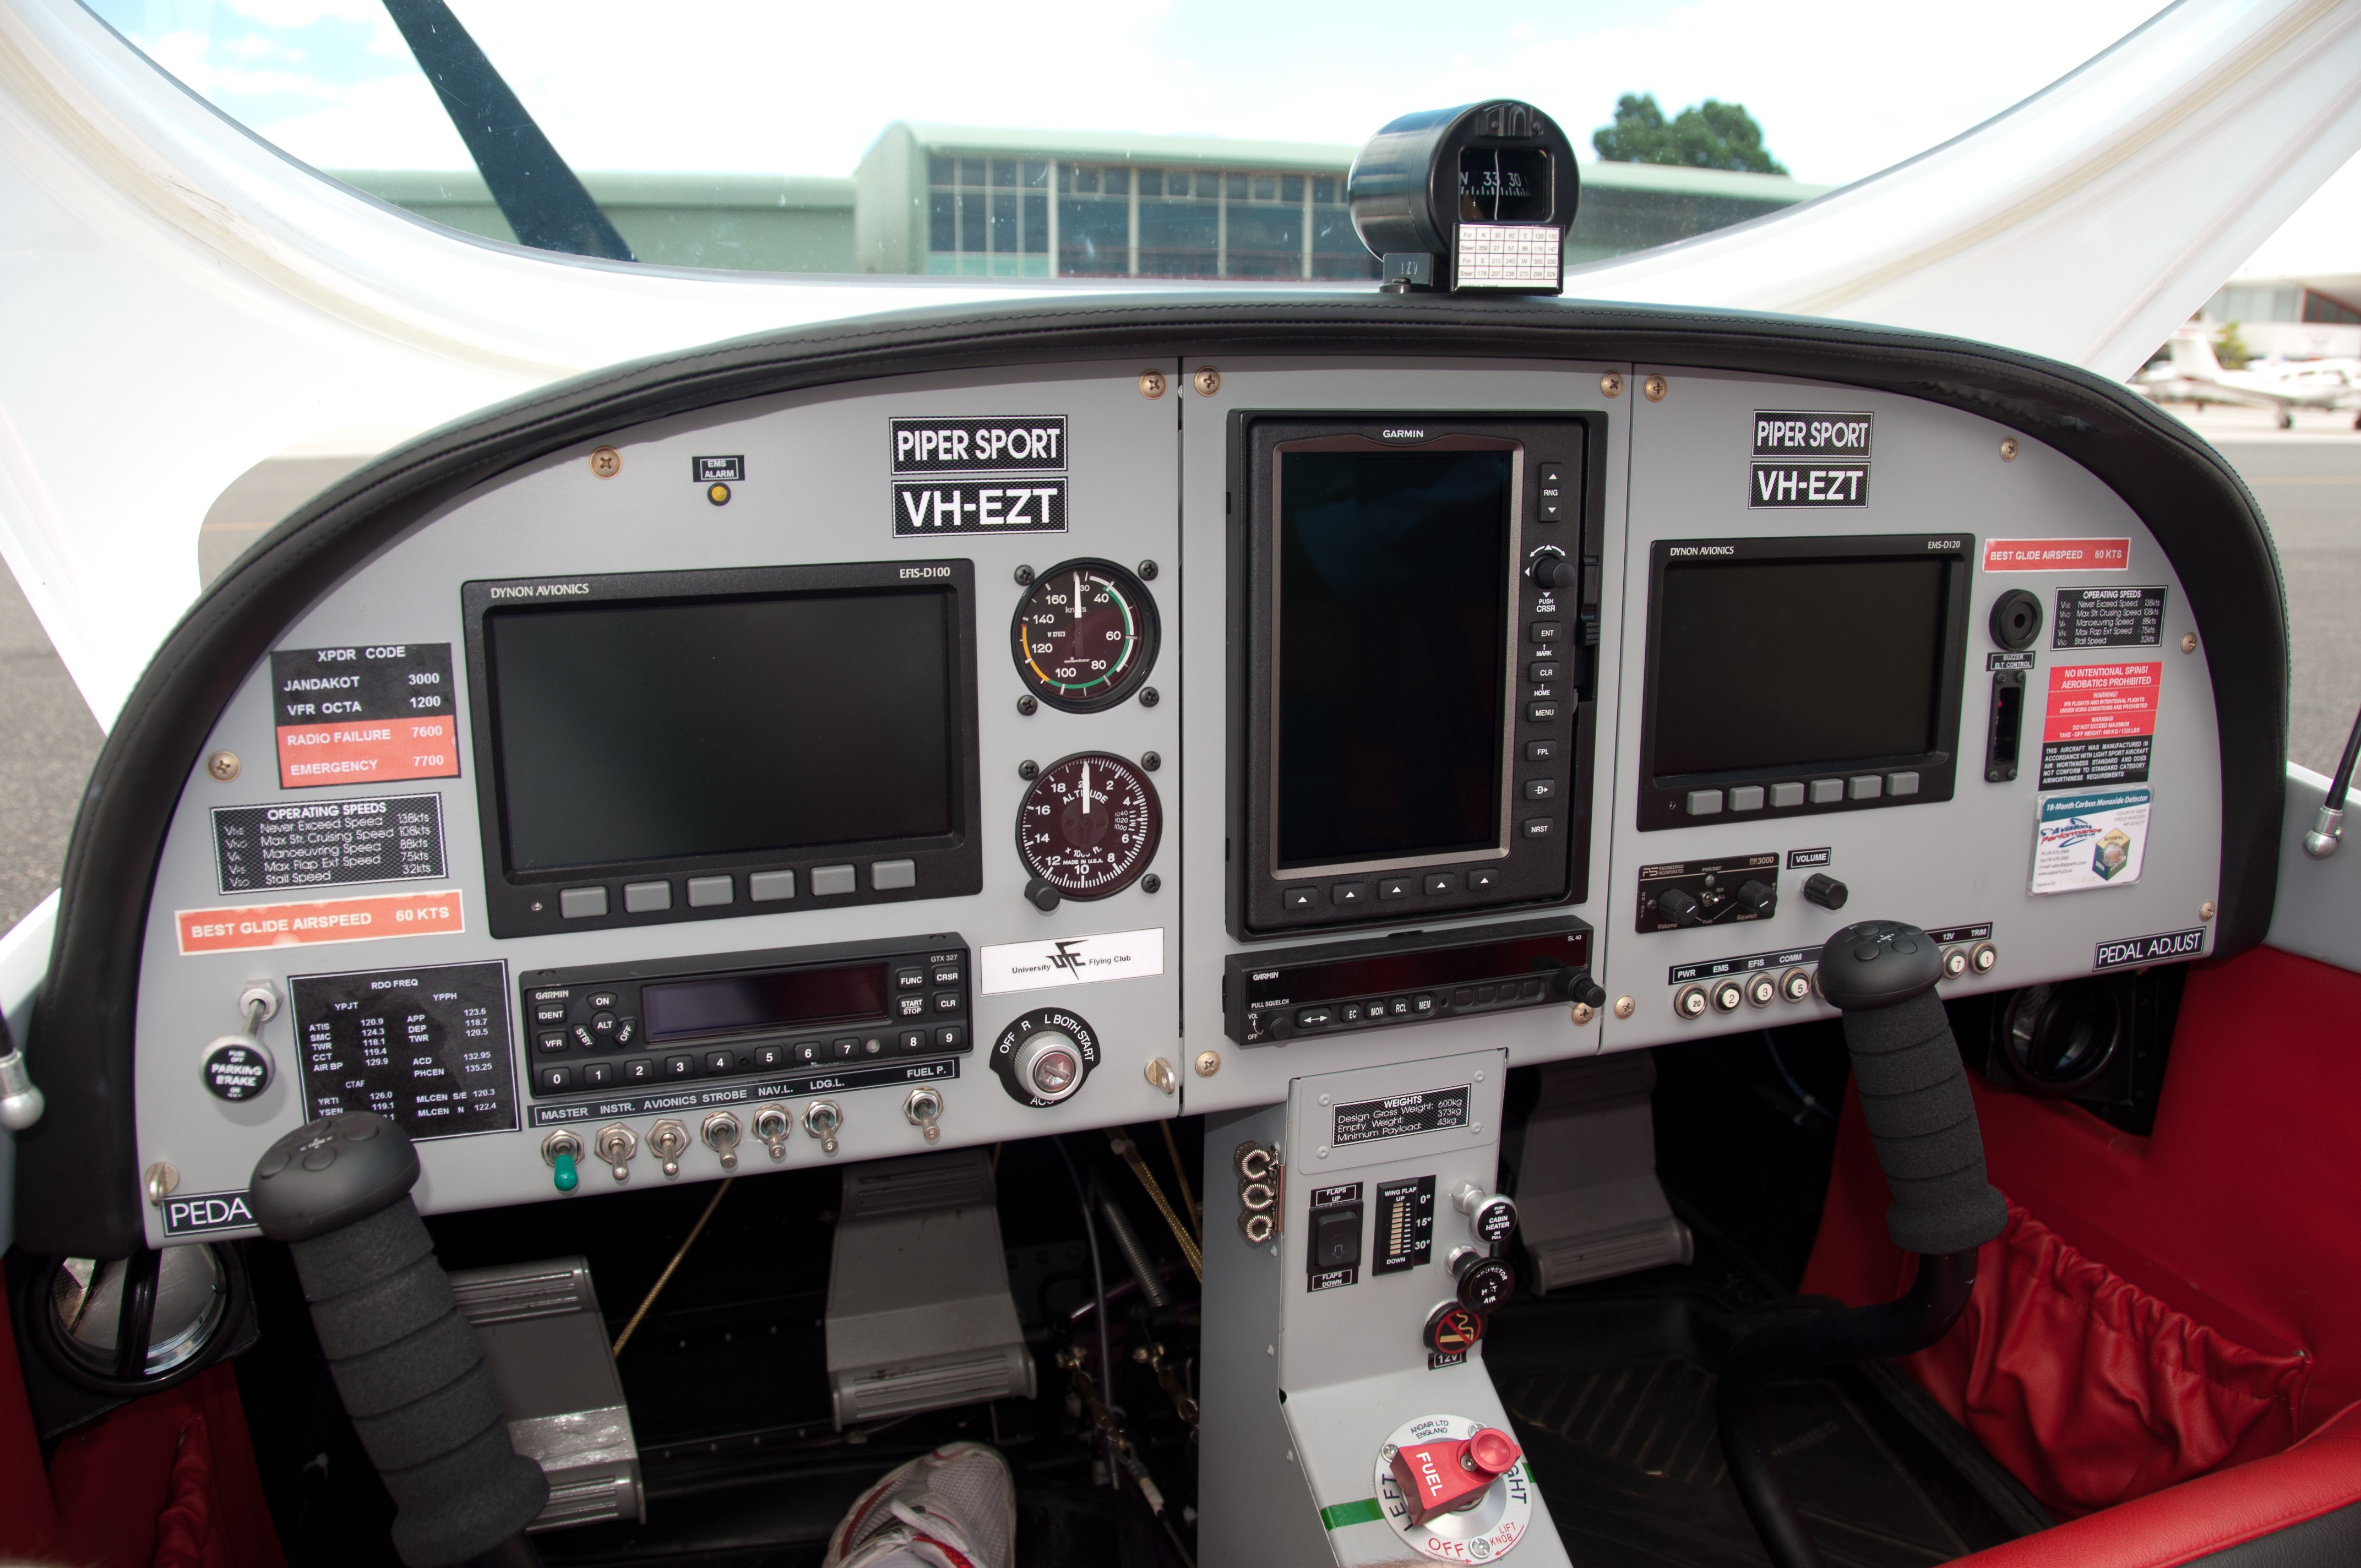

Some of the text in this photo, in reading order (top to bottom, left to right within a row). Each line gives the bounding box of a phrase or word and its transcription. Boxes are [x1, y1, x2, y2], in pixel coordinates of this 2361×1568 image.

[1509, 172, 1521, 187] 30
[1757, 421, 1868, 447] PIPER SPORT
[898, 428, 1060, 461] PIPER SPORT
[708, 460, 726, 468] EMS
[704, 469, 735, 478] ALARM
[1758, 471, 1863, 501] VH-EZT
[902, 488, 1058, 527] VH-EZT
[1670, 546, 1734, 556] DYNON AVIONICS
[1928, 541, 1960, 549] EMS-D120
[1990, 552, 2014, 560] BEST
[2015, 551, 2040, 560] GLIDE
[2042, 551, 2082, 559] AIRSPEED
[2106, 550, 2121, 558] KTS
[900, 567, 950, 579] EFIS-D100
[491, 583, 590, 598] DYNON AVIONICS
[1046, 595, 1067, 605] 160
[1094, 593, 1109, 603] 40
[1106, 631, 1121, 640] 60
[318, 646, 406, 662] XPDR CODE
[1055, 668, 1076, 677] 100
[2077, 668, 2123, 677] INTENTIONAL
[2125, 666, 2148, 674] SPINS!
[284, 673, 439, 692] JANDAKOT 3000
[2061, 677, 2151, 689] AEROBATICS PROHIBITED
[287, 695, 441, 716] VFR OCTA 1200
[287, 726, 443, 746] RADIO FAILURE 7600
[290, 755, 444, 776] EMERGENCY 7700
[2097, 797, 2124, 807] Monoxide
[2125, 795, 2148, 803] Detector
[267, 803, 387, 820] OPERATING SPEEDS
[1035, 805, 1051, 815] 16
[260, 813, 429, 834] Never Exceed Speed 138kts
[1035, 834, 1049, 842] 14
[1796, 853, 1827, 863] VOLUME
[192, 907, 449, 938] BEST GLIDE AIRSPEED 60 KTS
[1678, 928, 1986, 978] PWR EMS EFIS COMM TRIM
[2099, 933, 2201, 965] PEDAL ADJUST
[1012, 964, 1051, 974] University
[1089, 957, 1111, 966] Flying
[901, 972, 958, 985] FUNC CRSR
[1253, 971, 1279, 981] GARMIN
[372, 979, 418, 990] RDO FREQ
[535, 990, 569, 1000] GARMIN
[335, 993, 457, 1011] YPJT YPPH
[941, 999, 955, 1008] CLR
[1265, 998, 1289, 1007] SQUELCH
[1419, 1000, 1431, 1010] MEM
[538, 1010, 563, 1020] IDENT
[1370, 1006, 1383, 1016] MON
[309, 1008, 486, 1032] ATIS 120.9 APP 123.6
[597, 1021, 612, 1029] ALT
[1053, 1014, 1081, 1033] BOTH
[545, 1039, 562, 1048] VFR
[1078, 1030, 1094, 1061] START
[463, 1052, 491, 1061] 132.95
[211, 1064, 263, 1076] PARKING
[414, 1063, 492, 1077] PHCEN 135.25
[216, 1076, 257, 1086] BRAKE
[345, 1080, 365, 1088] CTAF
[758, 1065, 946, 1097] NAV.L. LDG.L. FUEL P.
[541, 1089, 747, 1121] MASTER INSTR. AVIONICS STROBE
[1384, 1095, 1422, 1108] WEIGHTS
[1339, 1098, 1462, 1124] Design Gross Weight: 600kg
[1326, 1188, 1346, 1196] FLAPS
[1486, 1222, 1510, 1230] HEATER
[1322, 1278, 1342, 1287] DOWN
[1411, 1421, 1433, 1433] ANDAIR
[1416, 1428, 1448, 1439] ENGLAND
[1416, 1452, 1443, 1496] FUEL
[1498, 1522, 1516, 1534] LIFT
[1489, 1534, 1513, 1546] KNOB
[1428, 1538, 1464, 1557] OFF
